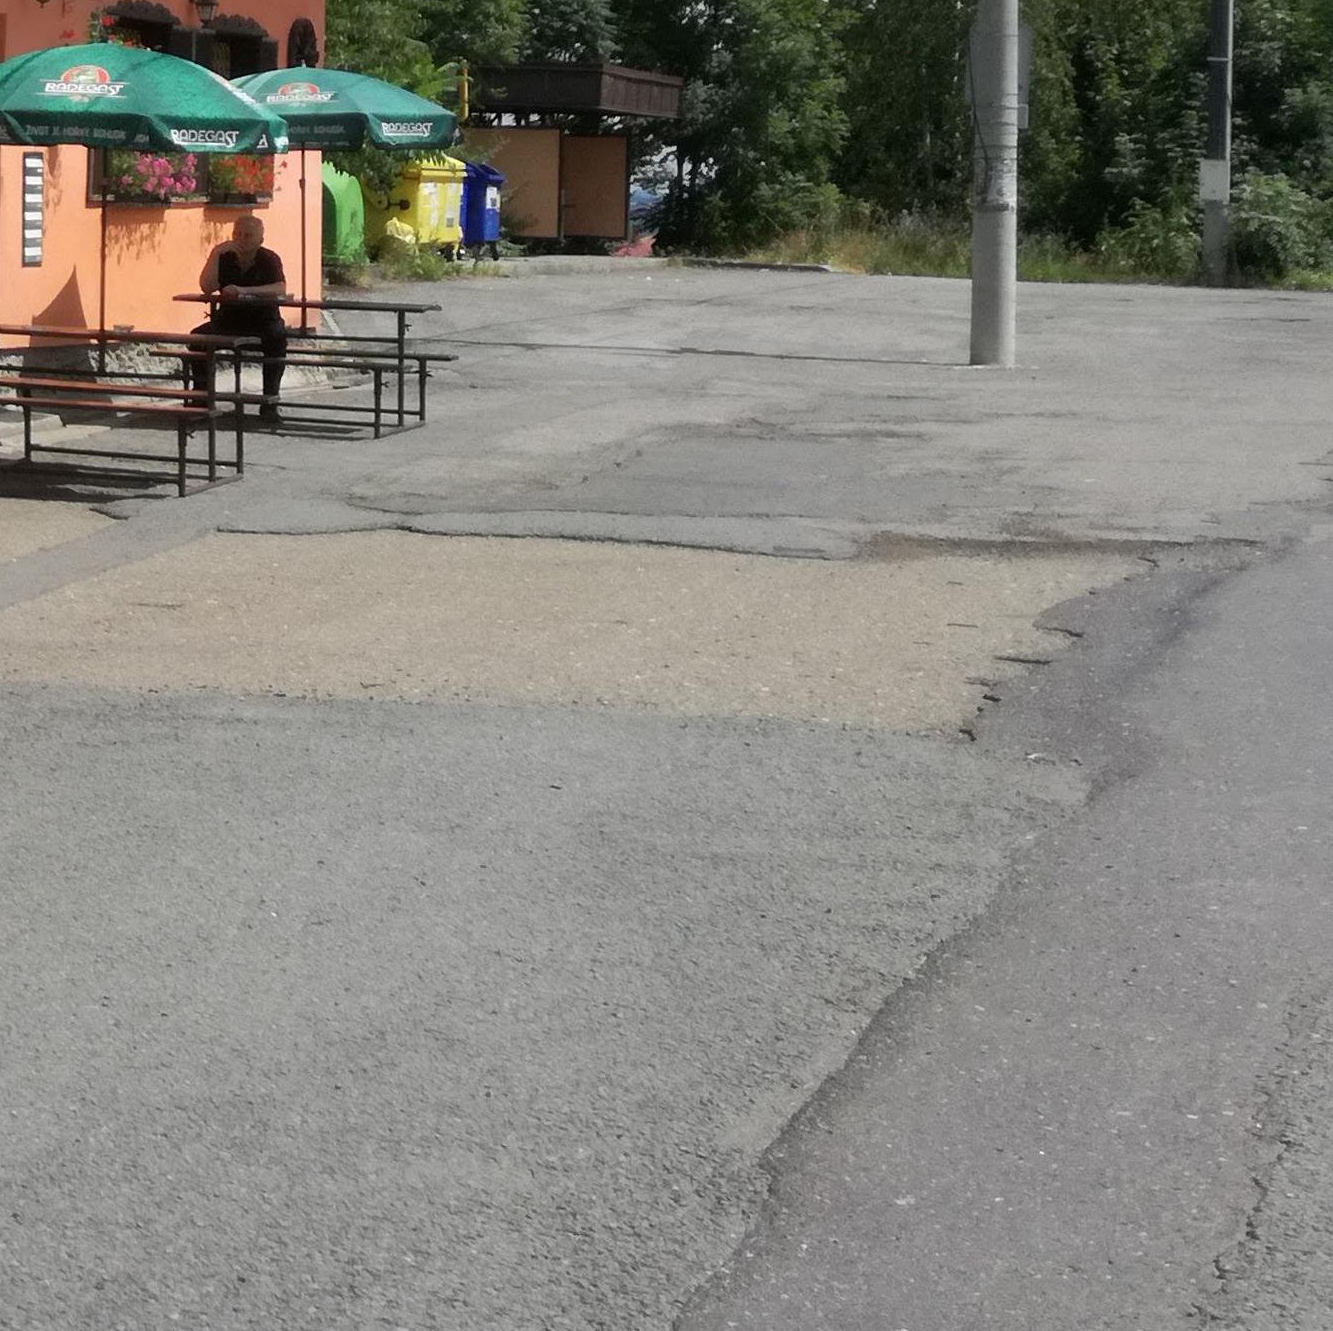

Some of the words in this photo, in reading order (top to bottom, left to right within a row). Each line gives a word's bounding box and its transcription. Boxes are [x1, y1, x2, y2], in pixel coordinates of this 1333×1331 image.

[44, 81, 126, 96] RADEGAST
[169, 128, 240, 148] RADEGAST
[381, 122, 434, 138] RADEGAST
